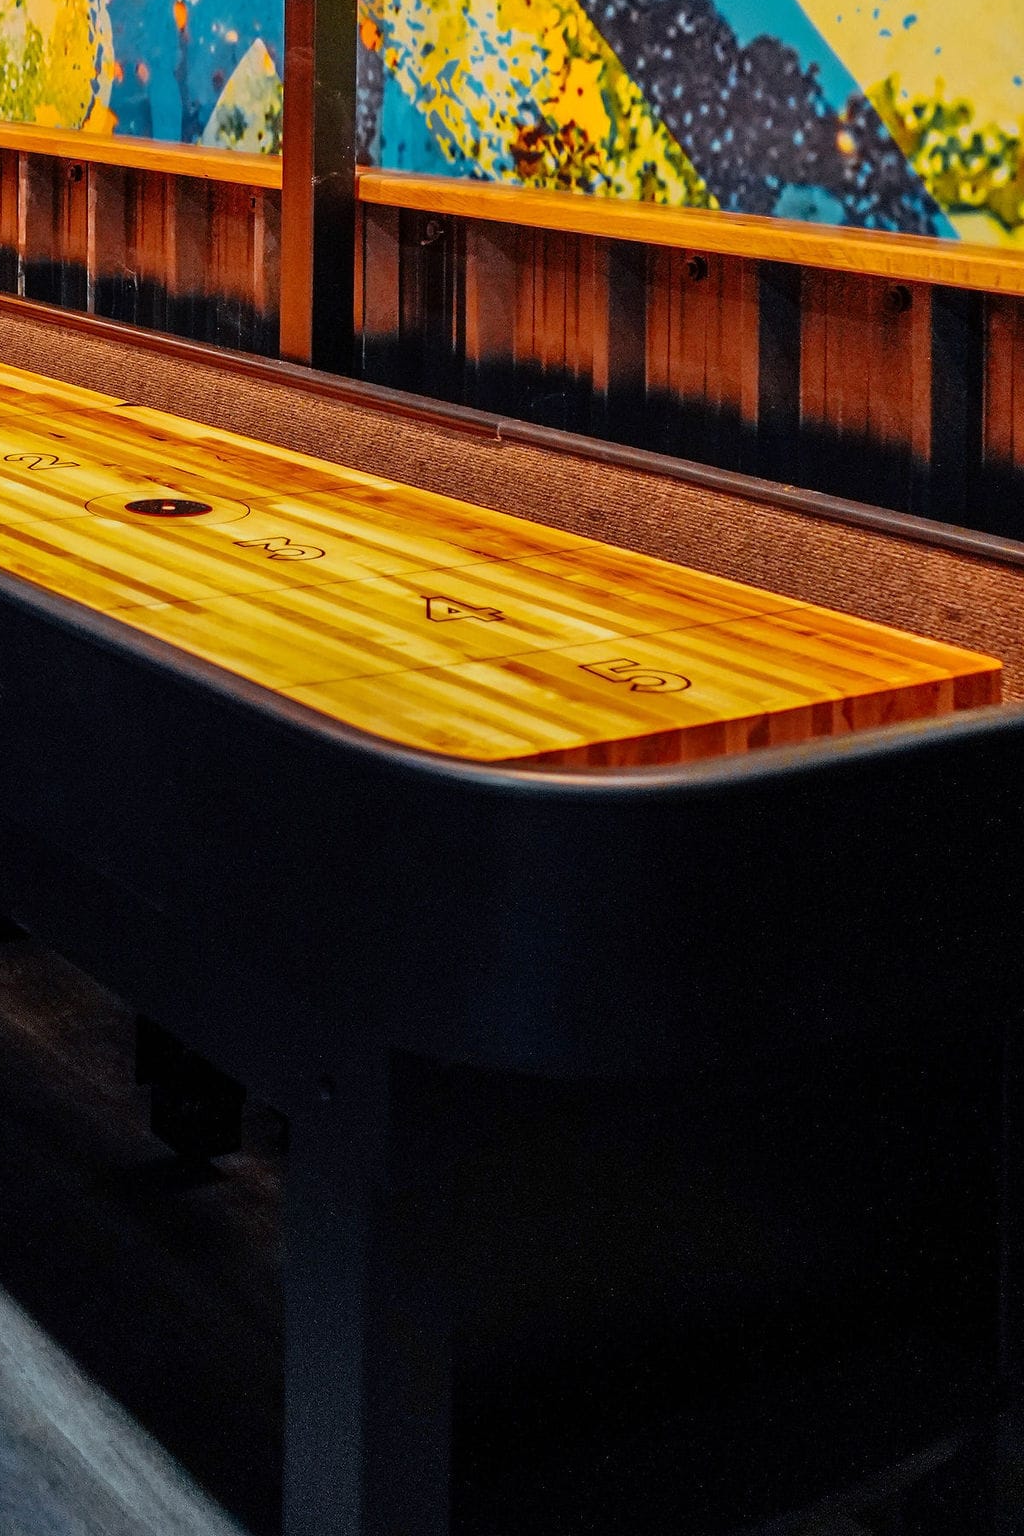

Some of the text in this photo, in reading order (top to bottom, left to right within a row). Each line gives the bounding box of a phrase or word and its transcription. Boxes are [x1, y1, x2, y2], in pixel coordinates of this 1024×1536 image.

[4, 452, 80, 471] 2
[232, 536, 326, 561] 3
[419, 594, 506, 623] 4
[578, 658, 692, 693] 5
